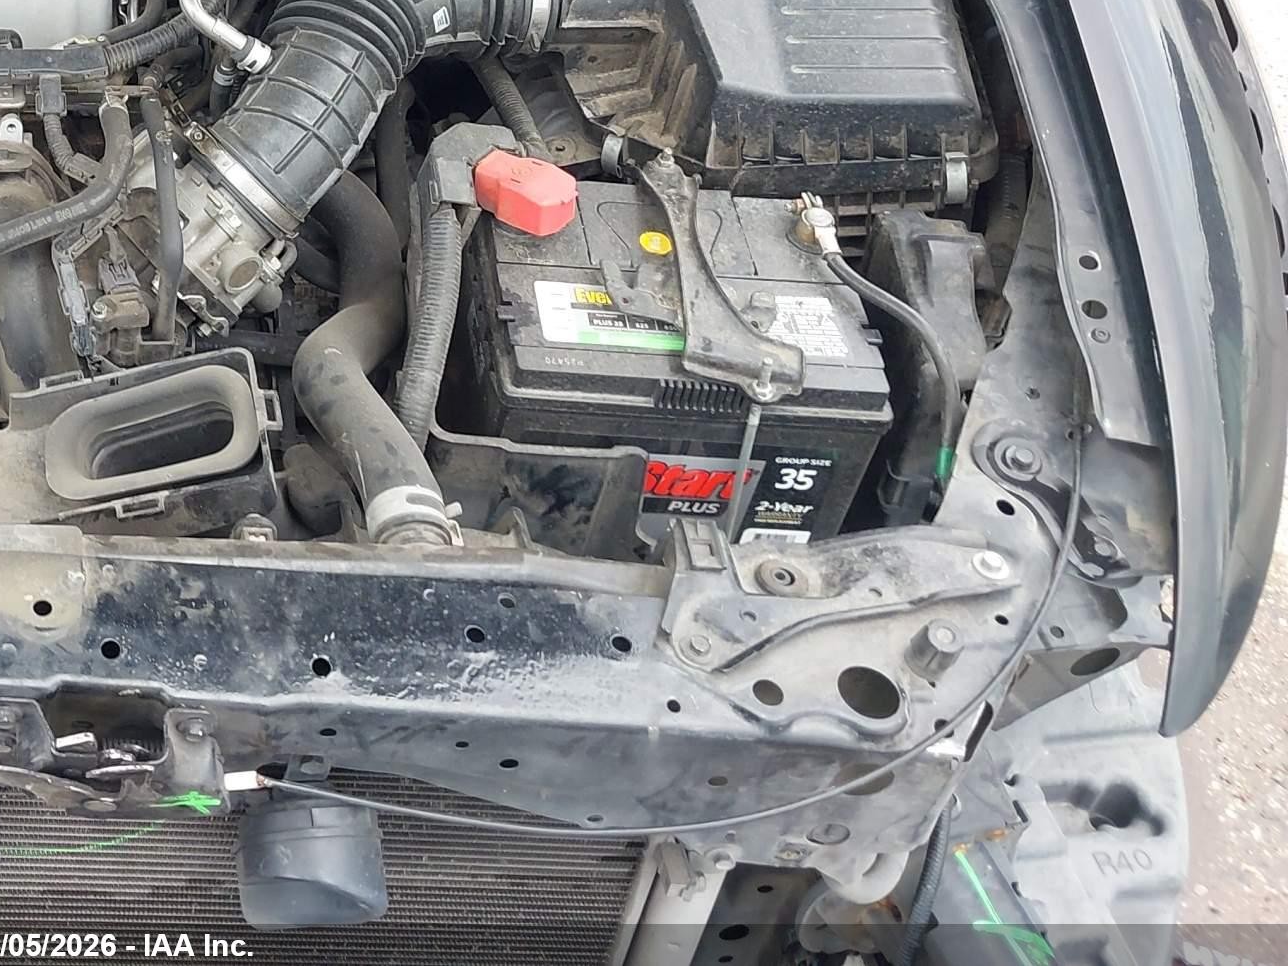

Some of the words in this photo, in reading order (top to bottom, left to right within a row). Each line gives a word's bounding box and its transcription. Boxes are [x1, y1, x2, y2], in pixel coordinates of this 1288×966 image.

[775, 456, 810, 465] GROUP
[810, 458, 832, 467] SIZE
[774, 467, 818, 491] 35
[667, 500, 721, 514] PLUS
[754, 500, 814, 514] 2-Year
[1091, 848, 1153, 876] R40
